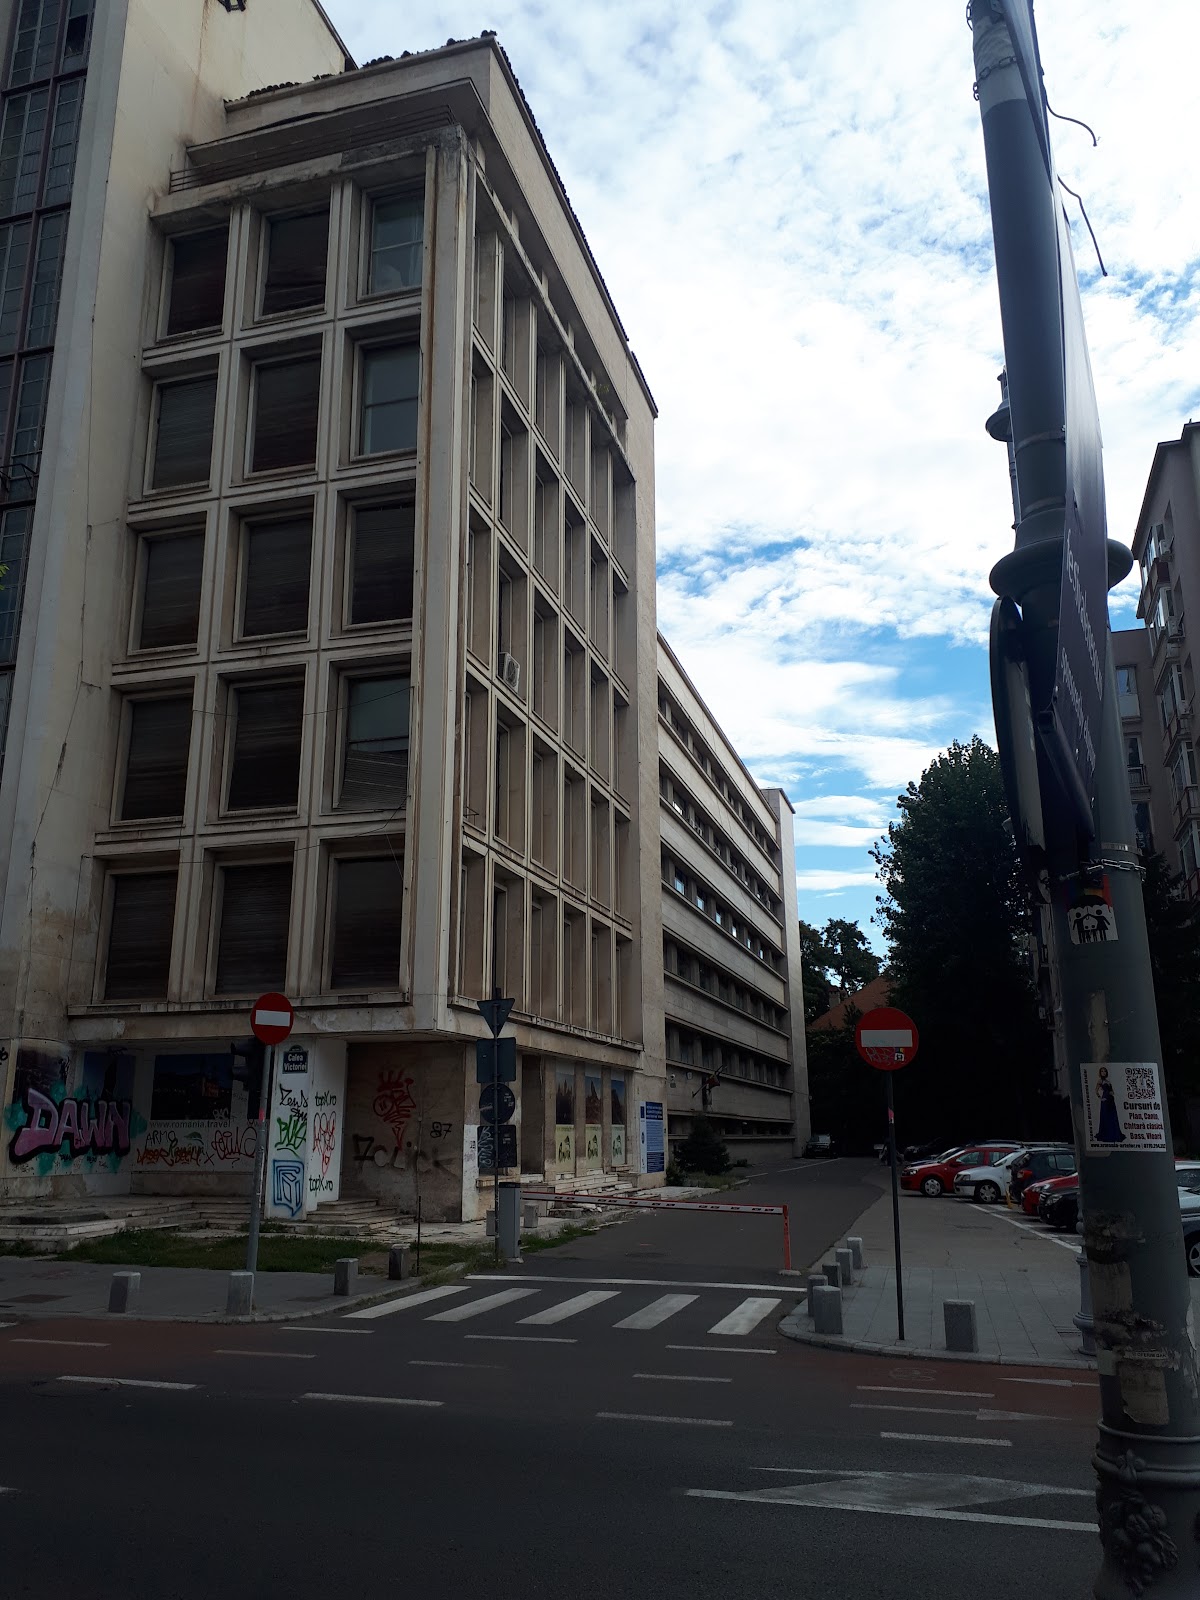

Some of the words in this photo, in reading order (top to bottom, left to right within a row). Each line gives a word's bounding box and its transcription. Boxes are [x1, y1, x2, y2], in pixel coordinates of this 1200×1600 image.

[288, 1053, 304, 1062] Calea
[284, 1063, 307, 1072] Victoriei
[1123, 1101, 1152, 1110] Cursuri
[1153, 1101, 1160, 1110] de
[10, 1087, 132, 1163] DAWN
[150, 1120, 231, 1129] www.romania.travel
